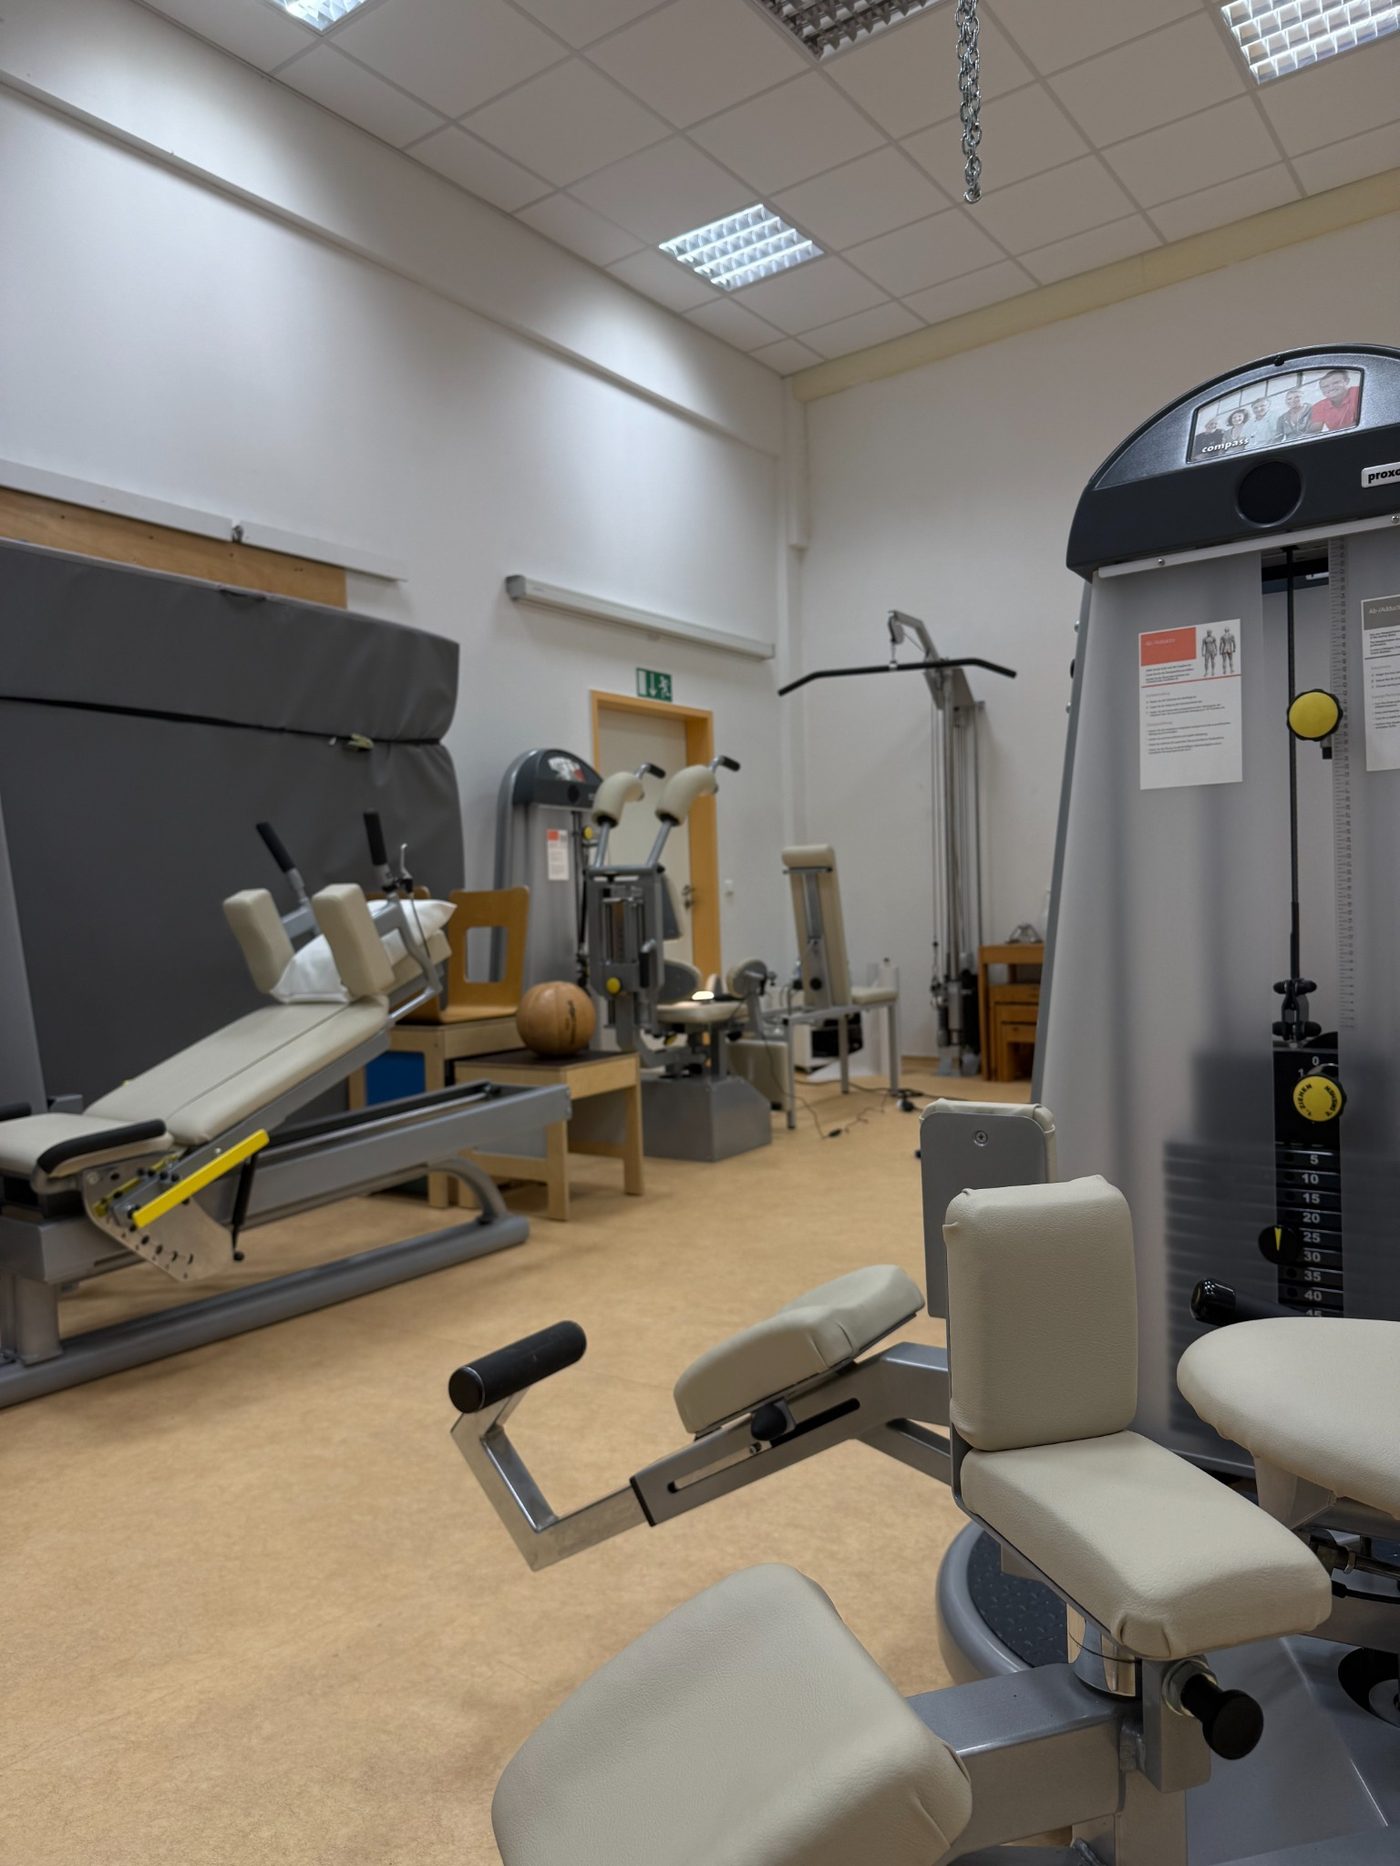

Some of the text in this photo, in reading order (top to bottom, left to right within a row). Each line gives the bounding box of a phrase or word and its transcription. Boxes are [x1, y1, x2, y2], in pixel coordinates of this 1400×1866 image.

[1201, 438, 1249, 453] compass
[1312, 1056, 1319, 1066] 0
[1297, 1083, 1312, 1109] ZIEHEN
[1310, 1154, 1319, 1165] 5
[1301, 1174, 1319, 1185] 10
[1302, 1193, 1320, 1204] 15
[1303, 1212, 1321, 1223] 20
[1303, 1232, 1321, 1243] 25
[1303, 1251, 1321, 1262] 30
[1304, 1270, 1321, 1282] 35
[1304, 1290, 1322, 1301] 40
